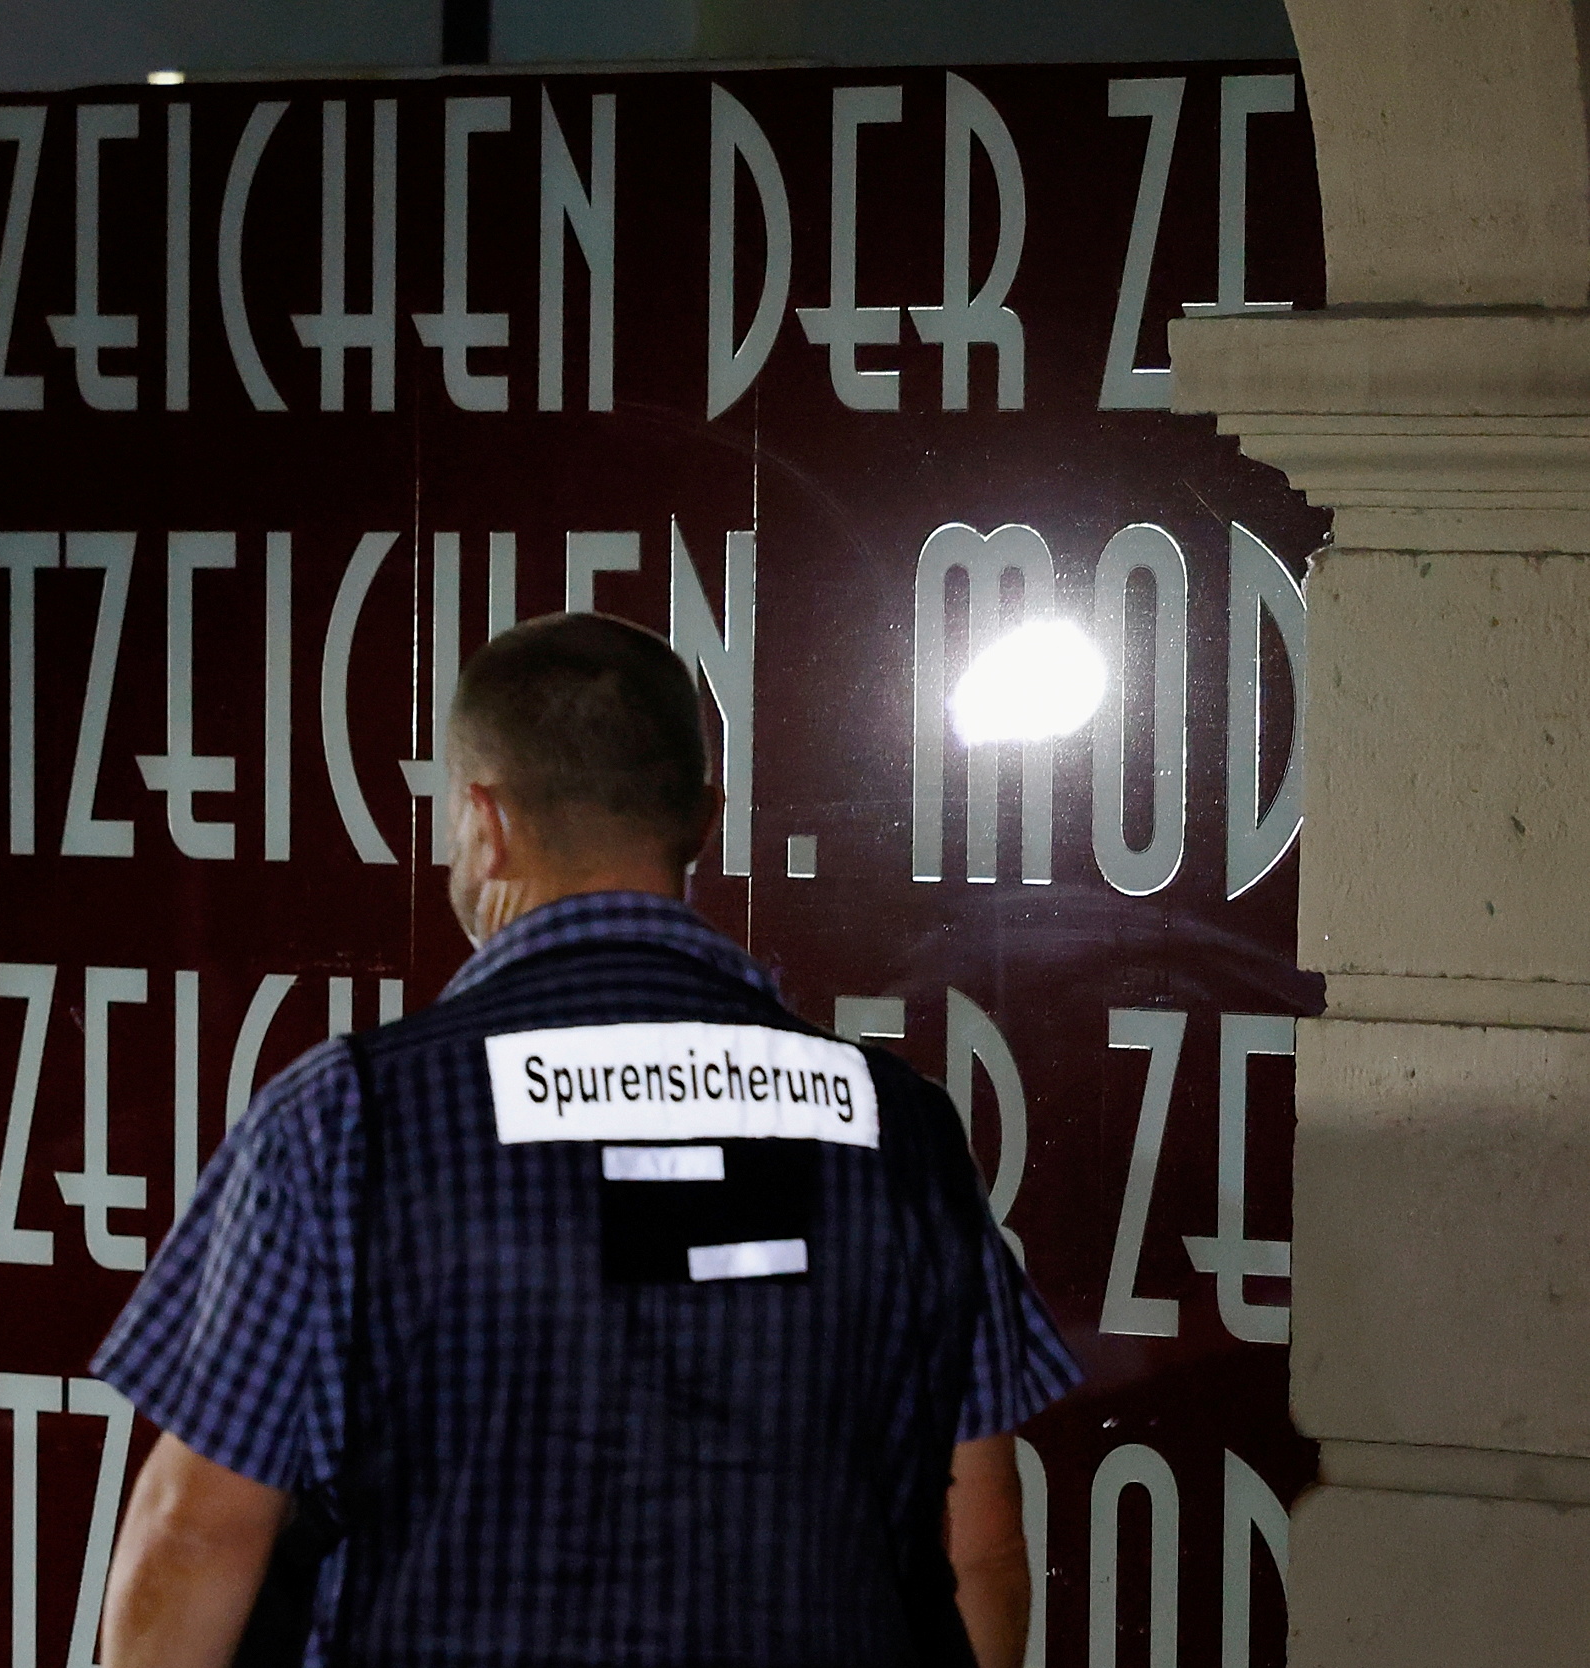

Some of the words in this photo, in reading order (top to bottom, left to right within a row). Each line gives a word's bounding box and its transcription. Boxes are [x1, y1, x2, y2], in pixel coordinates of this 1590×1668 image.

[707, 71, 1027, 422] DER
[911, 521, 1307, 901] MOD
[524, 1049, 855, 1123] Spurensicherung
[1098, 1007, 1296, 1344] ZE
